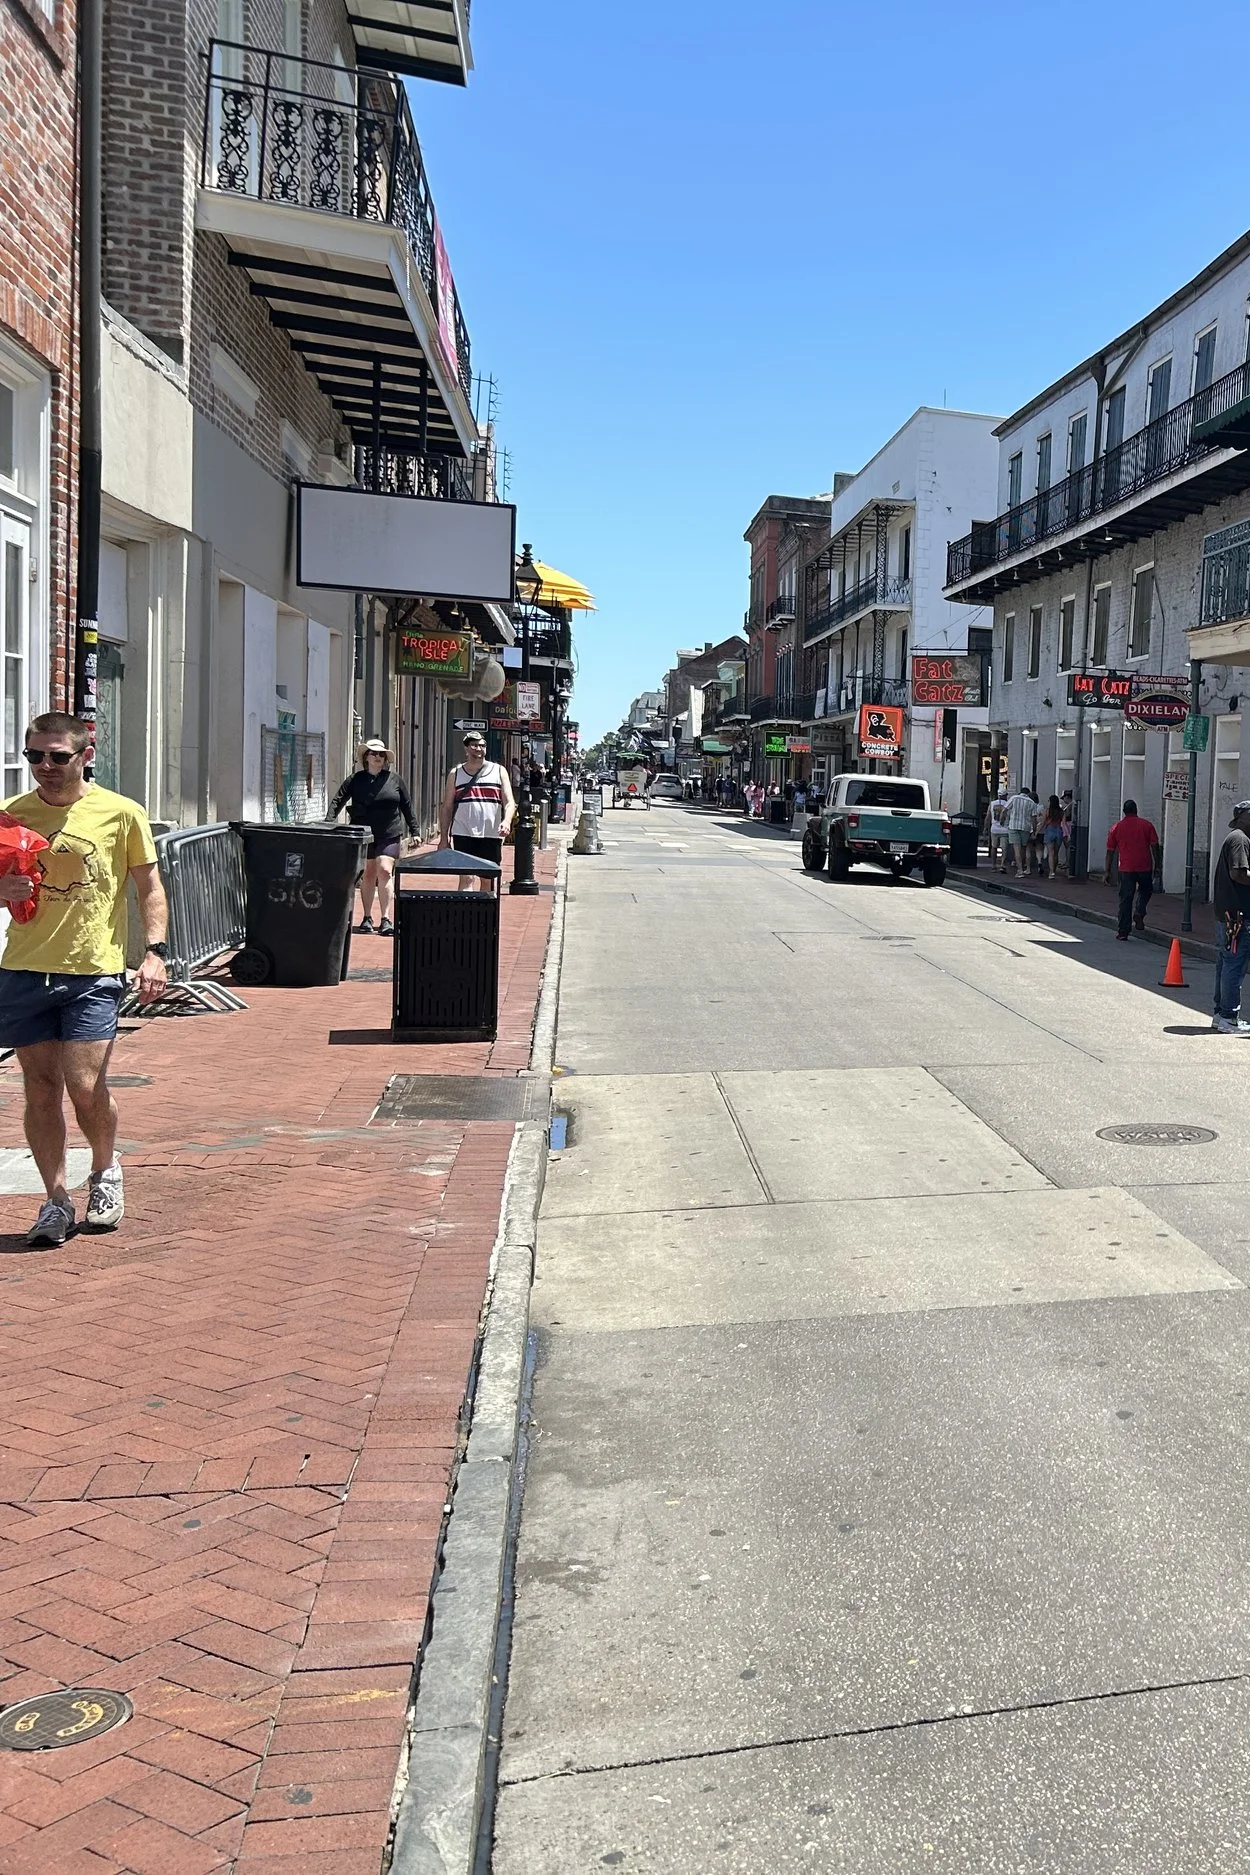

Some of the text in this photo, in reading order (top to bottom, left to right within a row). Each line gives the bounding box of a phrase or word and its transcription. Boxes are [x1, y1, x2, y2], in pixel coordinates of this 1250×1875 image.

[402, 636, 464, 652] TROPICAL
[420, 647, 449, 660] ISLE
[914, 657, 953, 679] Fat
[915, 681, 964, 702] Catz
[1128, 704, 1190, 716] DIXIELAN
[861, 741, 899, 751] CONCRETE
[865, 748, 895, 756] COWBOY
[1165, 773, 1188, 781] SPECI
